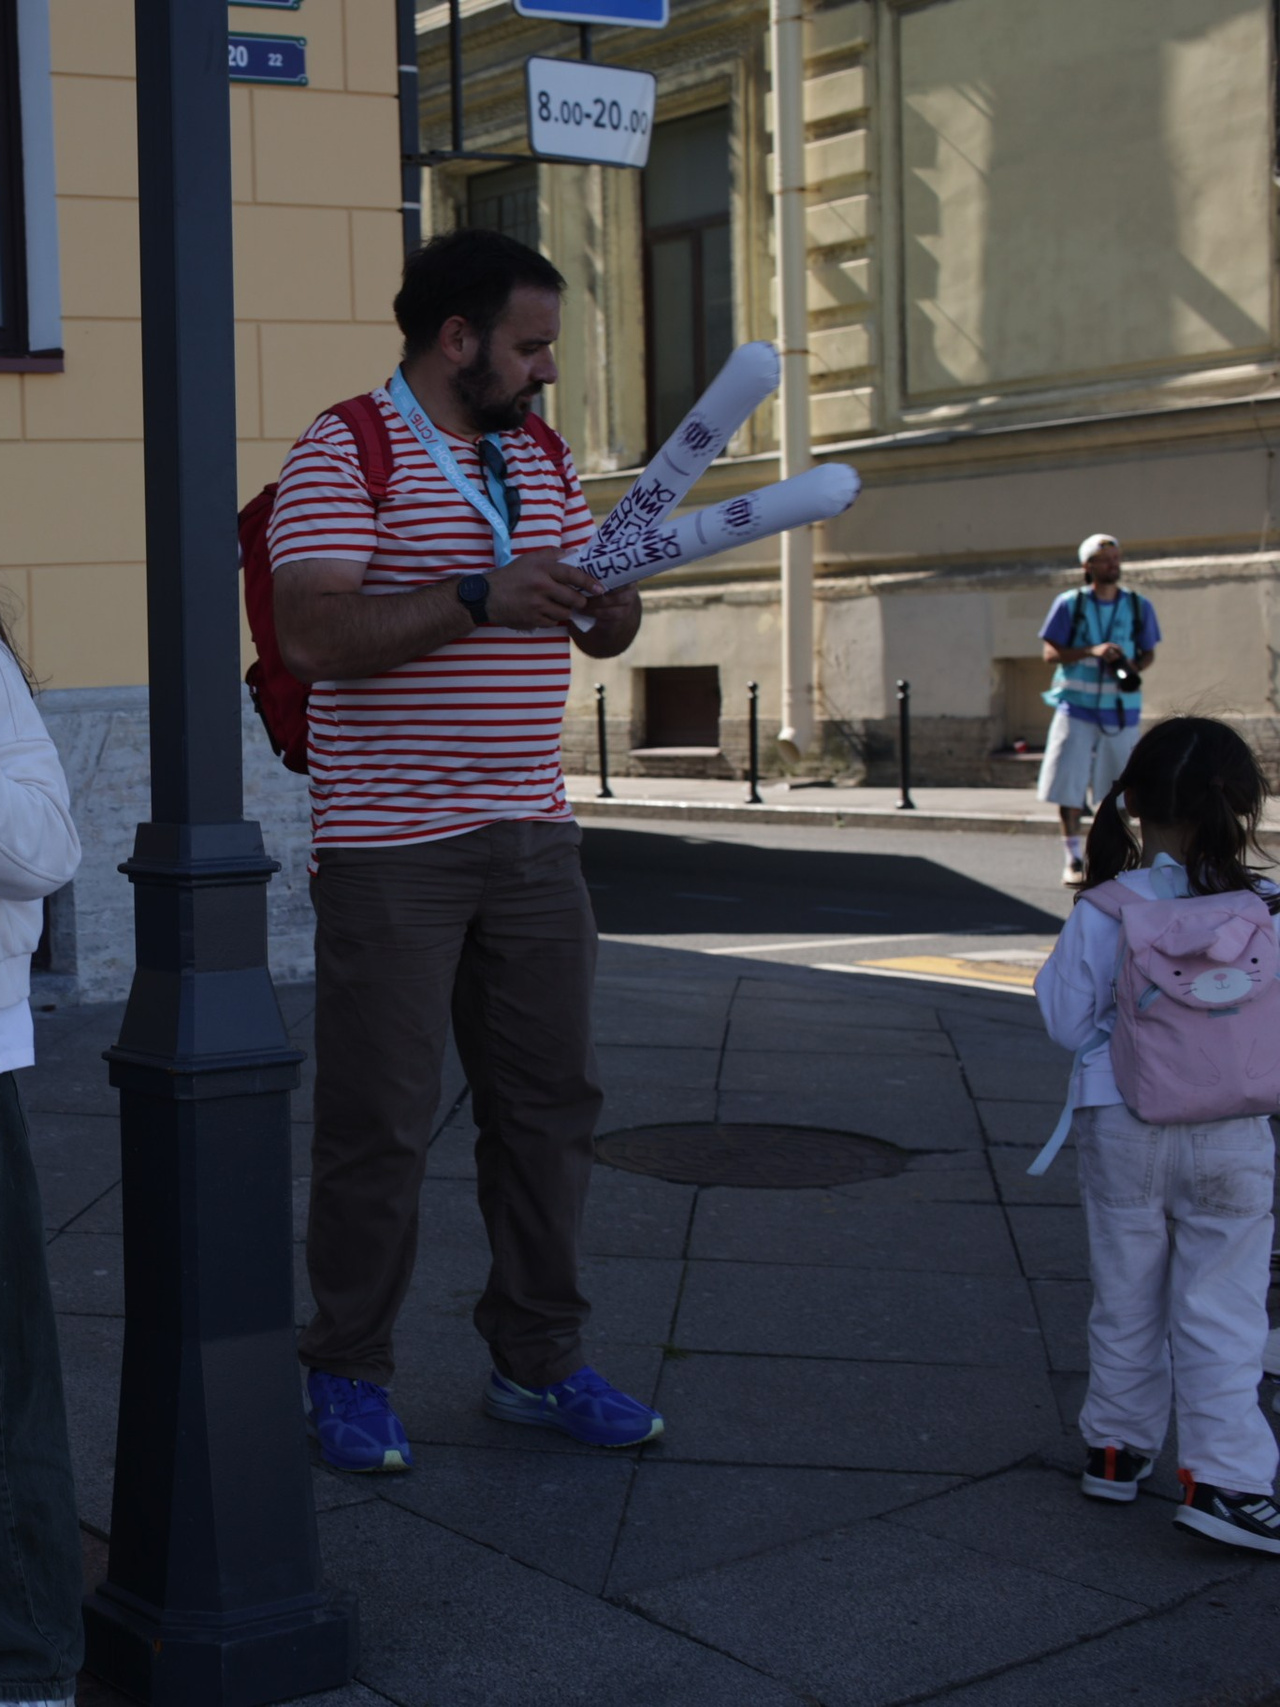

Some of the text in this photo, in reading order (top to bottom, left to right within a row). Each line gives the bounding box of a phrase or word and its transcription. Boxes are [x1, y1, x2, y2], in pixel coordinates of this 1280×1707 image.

[267, 52, 284, 67] 22
[537, 90, 649, 135] 8.00-20.00
[432, 444, 506, 530] ПОЛУМАРАФОН
